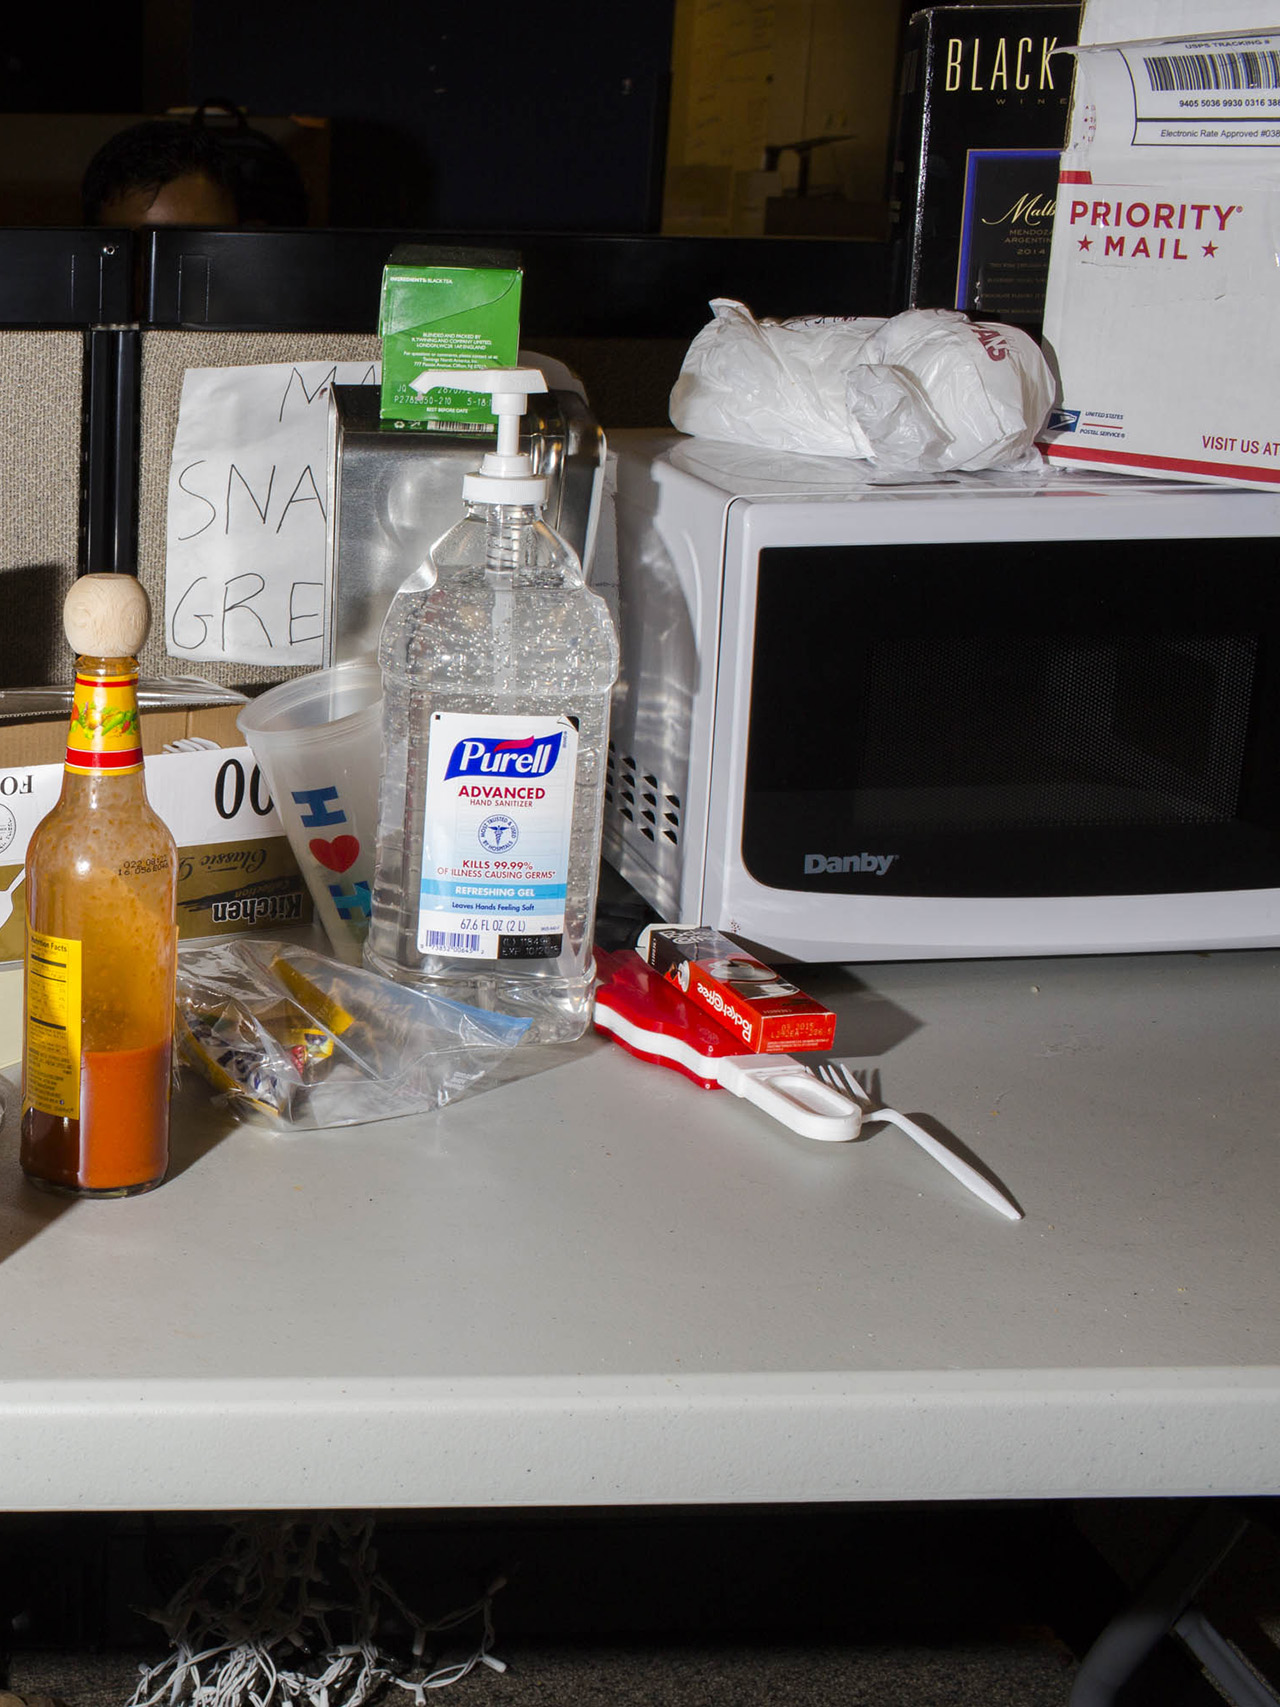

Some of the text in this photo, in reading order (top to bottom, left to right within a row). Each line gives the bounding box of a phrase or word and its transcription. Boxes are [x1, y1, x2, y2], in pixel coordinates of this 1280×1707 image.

[945, 37, 1058, 91] BLACK
[1179, 99, 1198, 108] 9405
[1222, 99, 1242, 107] 9930
[1244, 98, 1265, 107] 0316
[1160, 129, 1197, 138] Electronic
[1199, 129, 1219, 138] Rate
[1220, 129, 1259, 139] Approved
[1070, 200, 1237, 231] PRIORITY
[1009, 228, 1053, 236] MENDOZ
[1105, 236, 1188, 260] MAIL
[1104, 412, 1124, 420] STATES
[1079, 428, 1098, 436] POSTAL
[1202, 435, 1280, 456] VISIT US AT
[172, 573, 324, 651] GRE
[459, 741, 552, 774] Purell
[458, 785, 546, 800] ADVANCED
[470, 799, 533, 808] HAND SANITIZER
[201, 848, 268, 874] Classic
[463, 860, 533, 870] KILLS 99.99%
[804, 852, 893, 876] Danby
[437, 867, 449, 875] OF
[451, 868, 482, 878] ILLNESS
[484, 869, 522, 879] CAUSING
[455, 886, 535, 897] REFRESHING GEL
[212, 893, 304, 925] Kitchen
[452, 902, 474, 910] Leaves
[497, 903, 520, 912] Feeling
[460, 919, 478, 931] 67.6
[481, 919, 492, 931] FL
[493, 920, 504, 931] OZ
